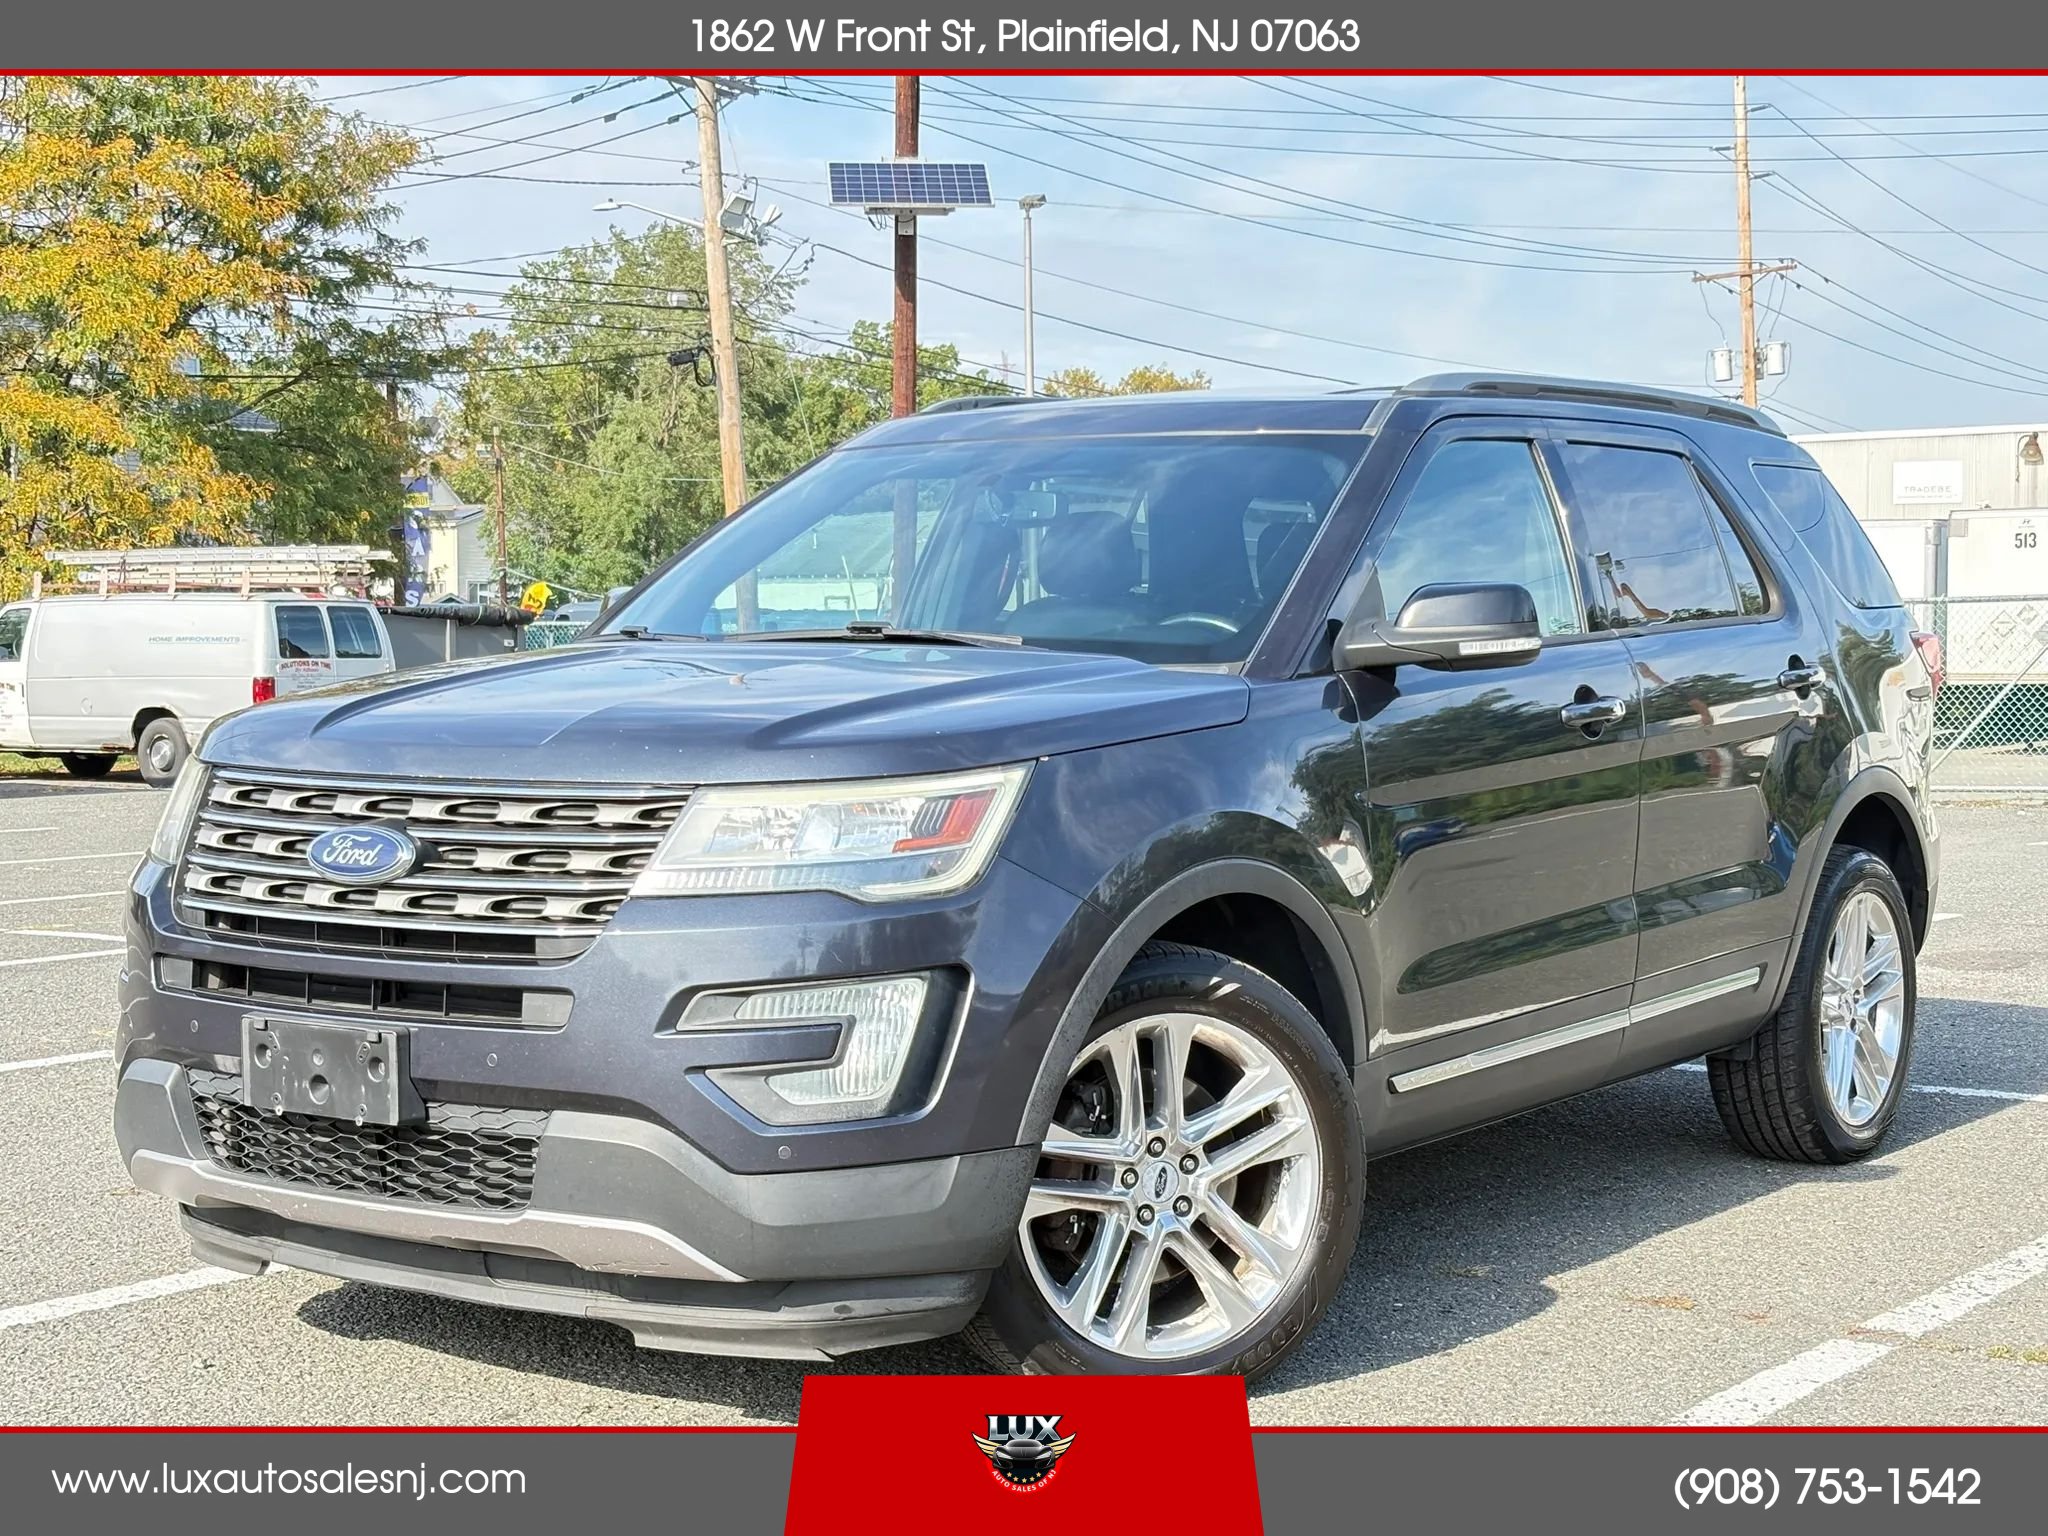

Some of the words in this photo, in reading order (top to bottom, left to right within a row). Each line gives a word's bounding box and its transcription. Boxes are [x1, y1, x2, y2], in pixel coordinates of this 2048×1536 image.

[2015, 532, 2037, 549] 513
[280, 660, 310, 670] SOLUTIONS
[322, 833, 384, 866] Ford
